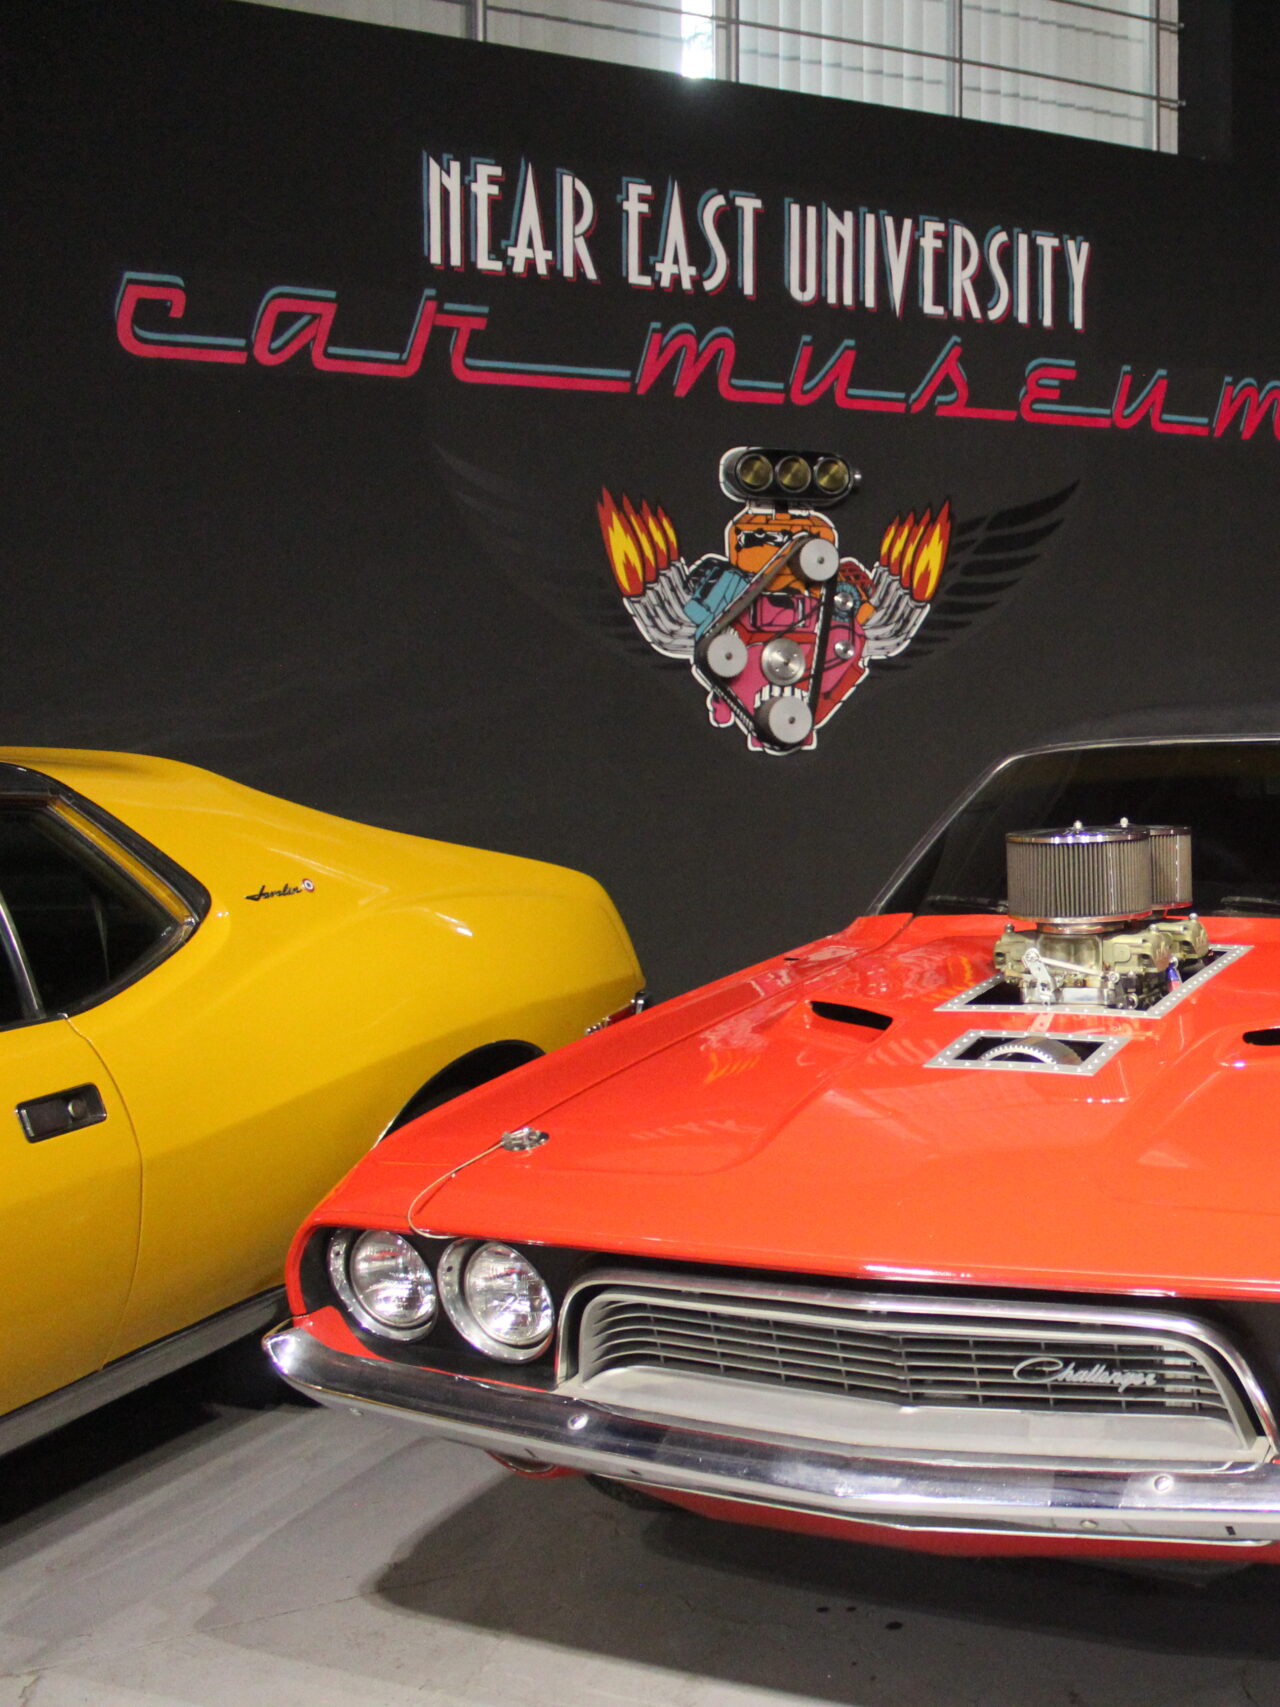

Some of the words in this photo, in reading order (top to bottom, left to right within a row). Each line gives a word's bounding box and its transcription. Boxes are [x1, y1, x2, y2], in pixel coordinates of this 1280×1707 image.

[423, 150, 599, 284] NEAR
[619, 175, 764, 299] EAST
[784, 197, 1090, 333] UNIVERSITY
[115, 271, 631, 393] car
[1013, 1356, 1157, 1393] Challenger
